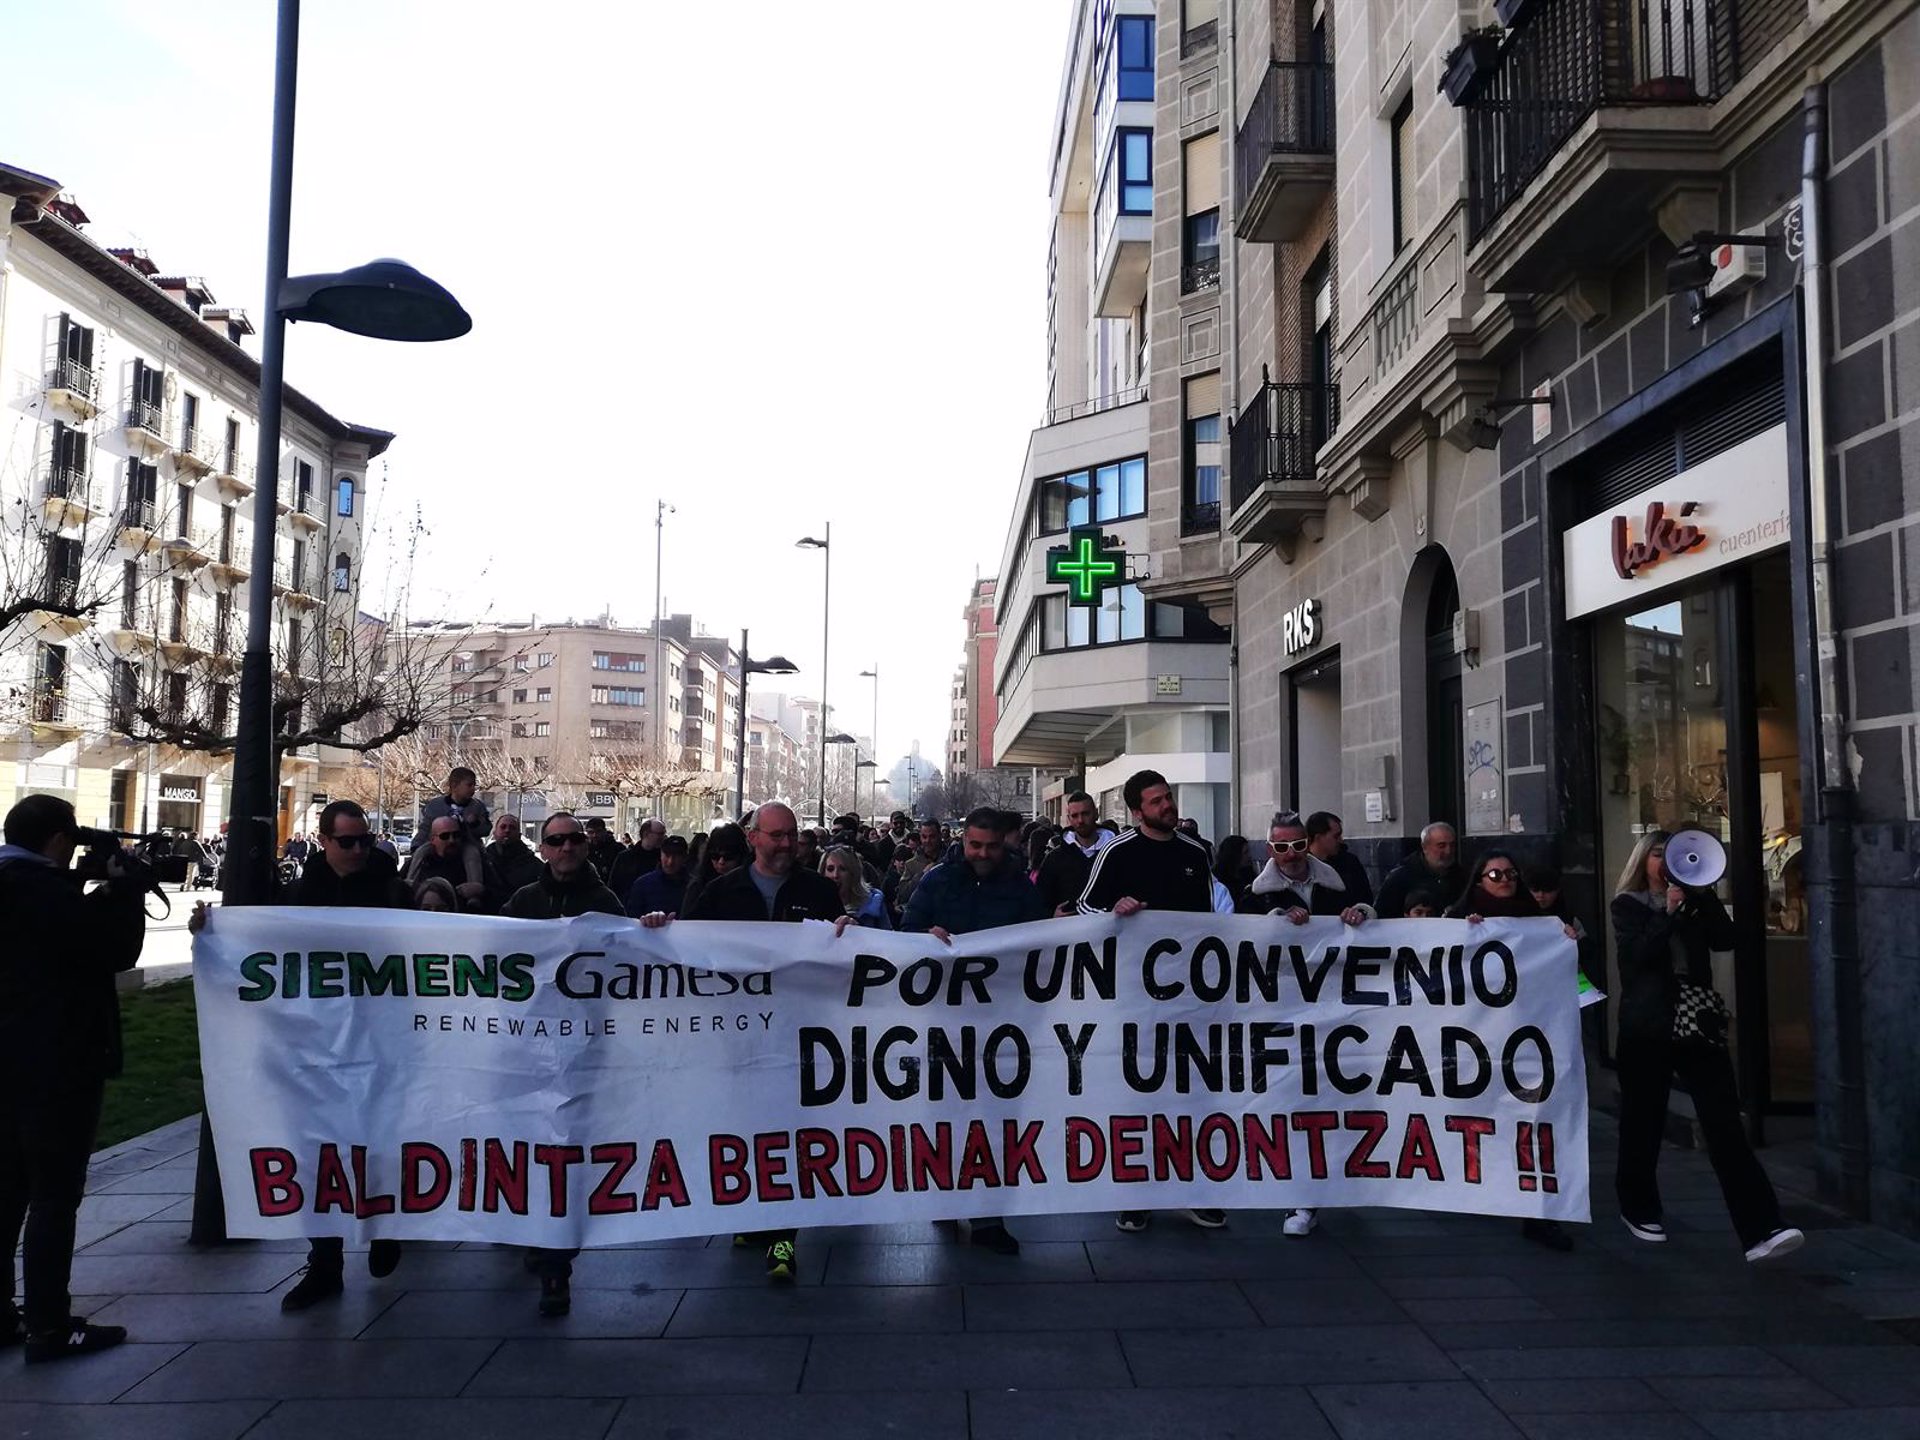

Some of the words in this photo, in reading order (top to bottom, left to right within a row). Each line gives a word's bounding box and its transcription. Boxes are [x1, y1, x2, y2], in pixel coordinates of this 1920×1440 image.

[1284, 598, 1317, 656] RKS
[164, 787, 197, 799] MANGO
[238, 951, 536, 1002] SIEMENS
[555, 951, 773, 1000] Gamesa
[847, 954, 999, 1007] POR
[1023, 936, 1118, 1003] UN
[1142, 936, 1518, 1008] CONVENIO
[414, 1013, 617, 1038] RENEWABLE
[642, 1011, 774, 1034] ENERGY
[798, 1023, 1032, 1107] DIGNO
[1053, 1023, 1098, 1096] Y
[1121, 1022, 1556, 1103] UNIFICADO
[249, 1138, 692, 1220] BALDINTZA
[708, 1118, 1048, 1206] BERDINAK
[1065, 1110, 1497, 1184] DENONTZAT
